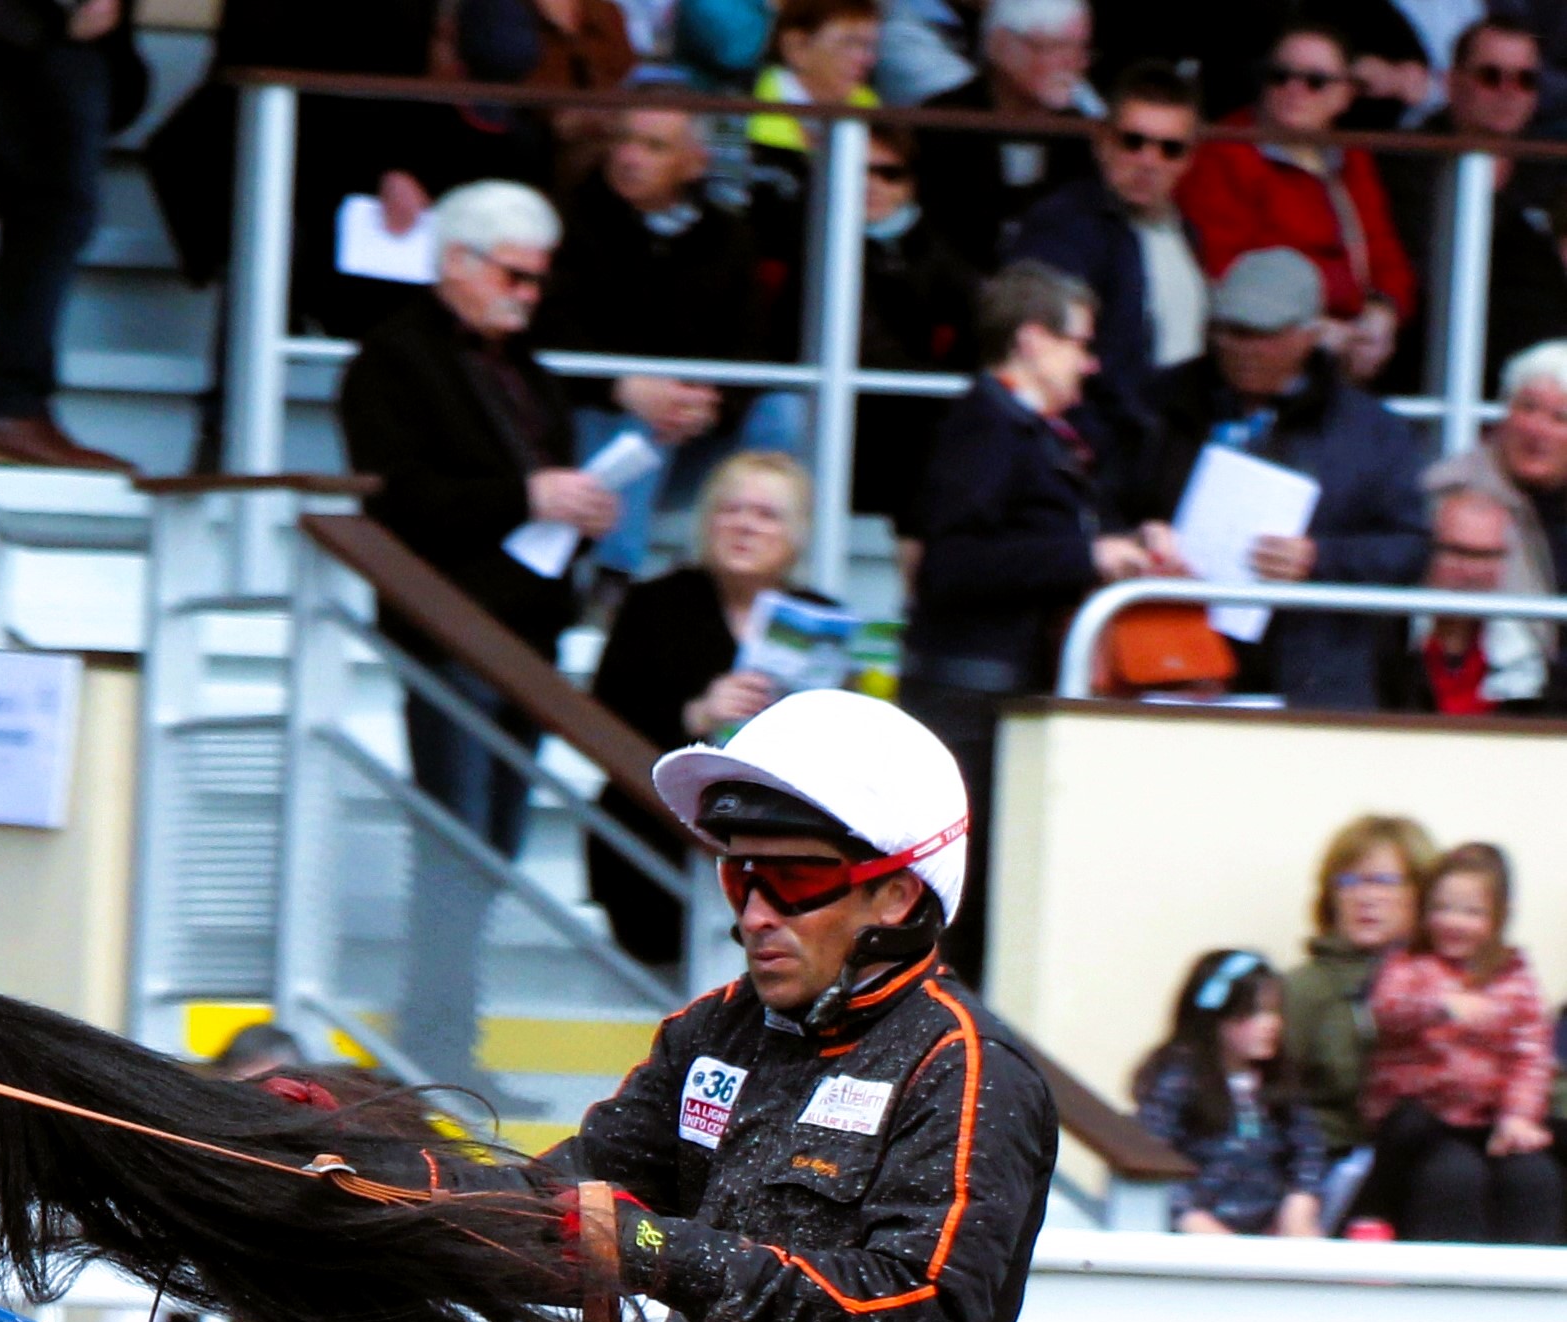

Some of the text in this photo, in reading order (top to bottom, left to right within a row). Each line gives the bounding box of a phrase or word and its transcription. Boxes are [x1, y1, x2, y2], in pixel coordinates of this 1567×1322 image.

[702, 1069, 737, 1104] 36
[685, 1100, 702, 1116] LA
[682, 1112, 707, 1130] INFO
